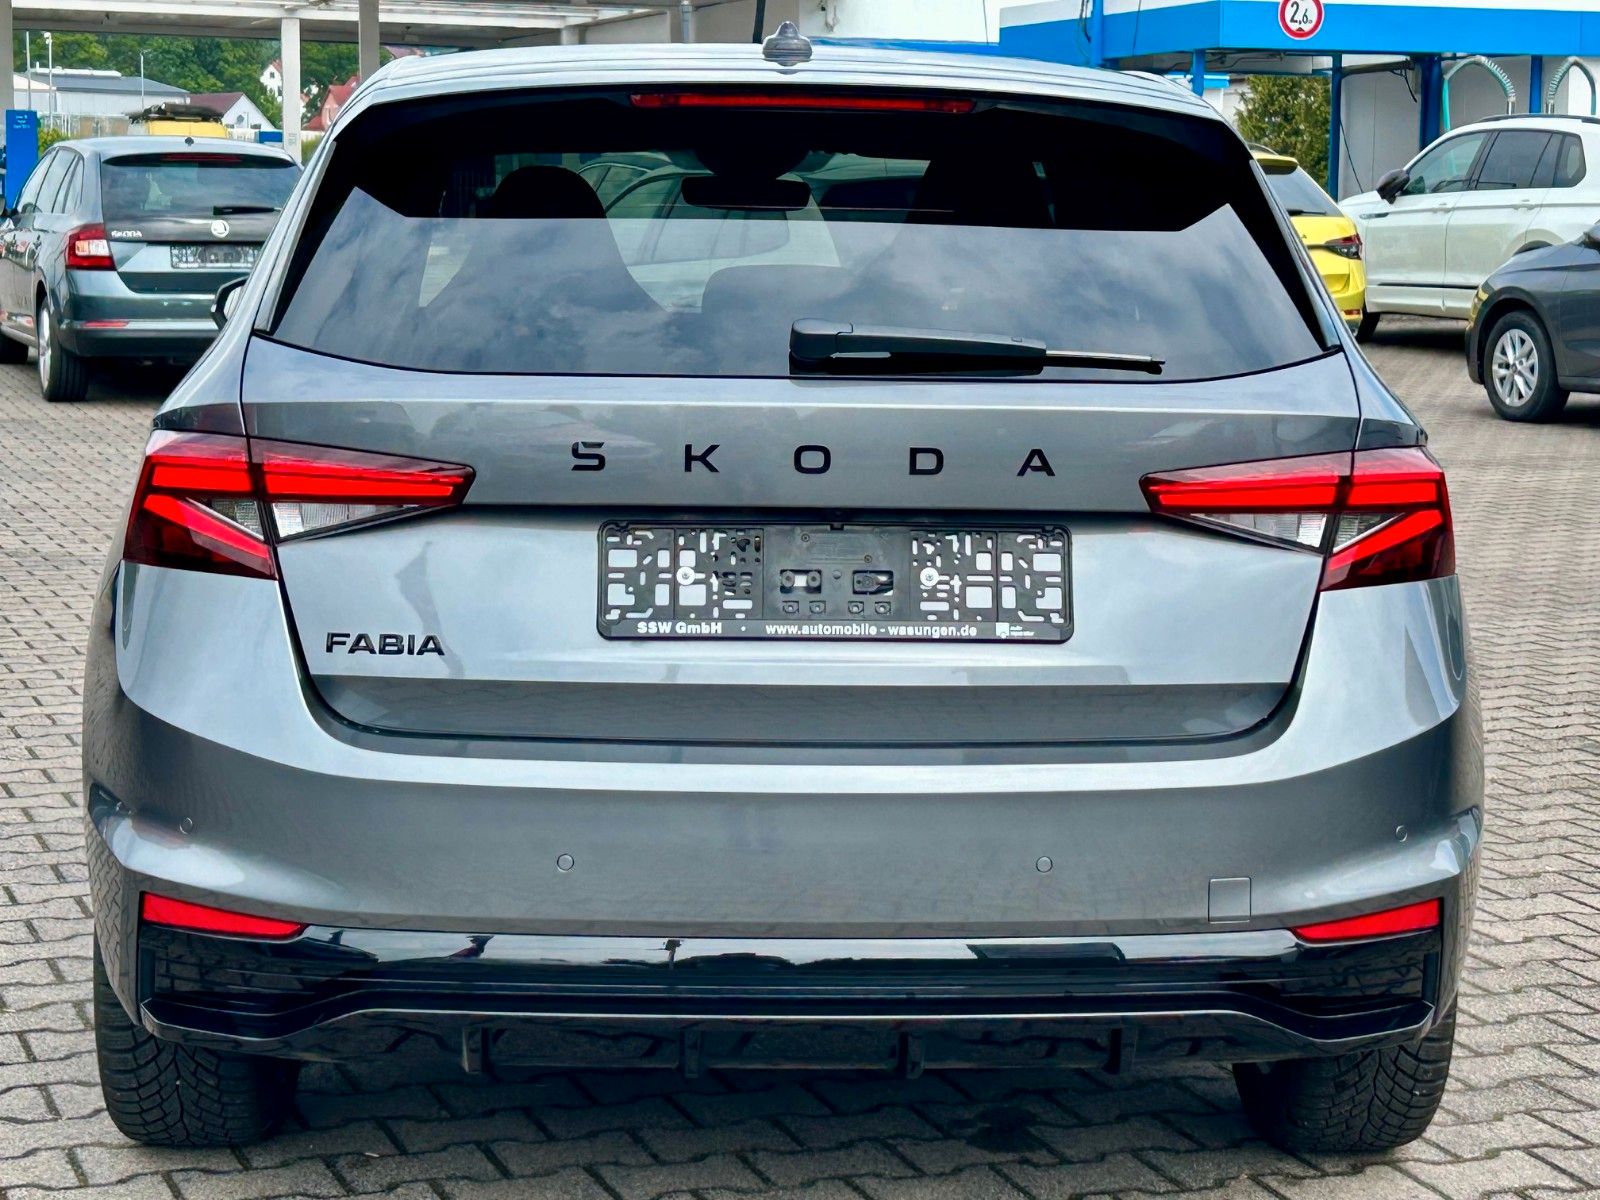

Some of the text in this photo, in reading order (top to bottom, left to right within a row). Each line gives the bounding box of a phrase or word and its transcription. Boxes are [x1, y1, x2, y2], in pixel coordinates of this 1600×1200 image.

[637, 621, 672, 634] SSW
[675, 621, 723, 634] GmbH
[325, 632, 445, 656] FABIA
